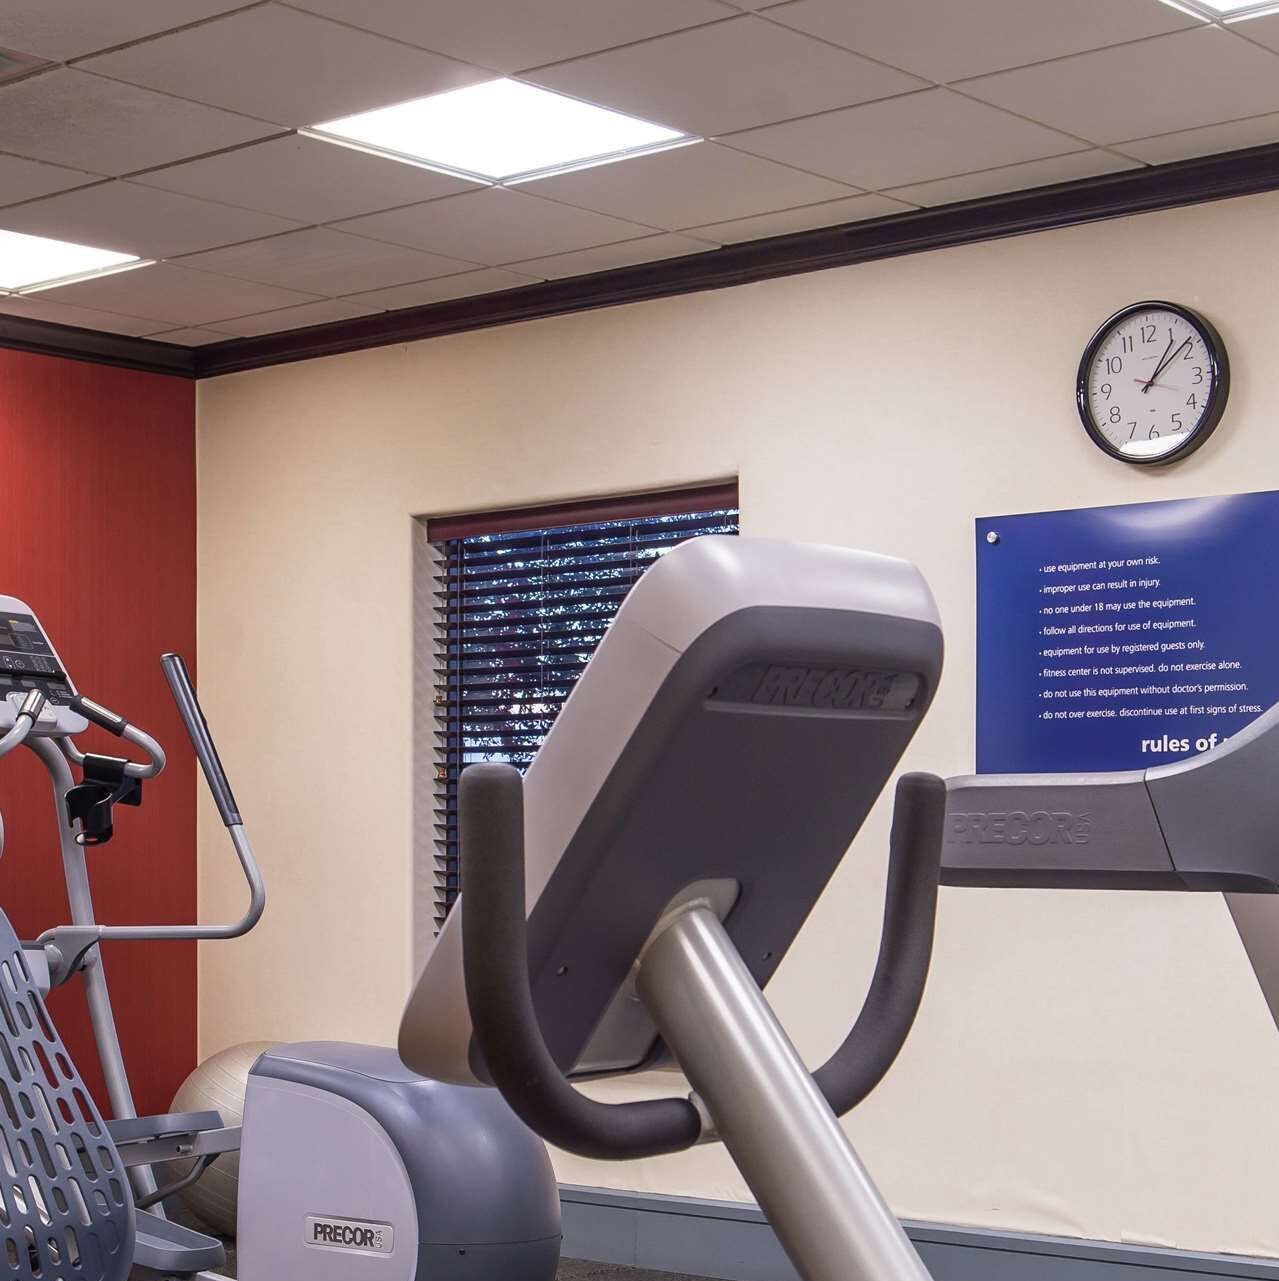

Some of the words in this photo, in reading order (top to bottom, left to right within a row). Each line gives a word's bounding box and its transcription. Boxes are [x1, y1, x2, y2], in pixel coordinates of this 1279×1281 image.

[1140, 324, 1157, 344] 12
[1122, 335, 1134, 354] 11
[1183, 340, 1195, 361] 2
[1105, 356, 1123, 375] 10
[1191, 366, 1203, 385] 3
[1100, 383, 1113, 401] 9
[1186, 392, 1198, 410] 4
[1109, 406, 1121, 424] 8
[1171, 412, 1183, 432] 5
[1127, 421, 1137, 440] 7
[1148, 424, 1160, 441] 6
[1043, 565, 1056, 573] use
[1058, 561, 1097, 573] equipment
[1099, 560, 1106, 569] at
[1108, 560, 1125, 570] your
[1146, 556, 1161, 565] risk.
[1043, 584, 1076, 595] improper
[1078, 583, 1091, 591] use
[1092, 582, 1106, 590] can
[1107, 580, 1128, 589] result
[1130, 579, 1137, 587] in
[1138, 578, 1161, 589] injury.
[1043, 606, 1054, 615] no
[1055, 606, 1070, 614] one
[1071, 603, 1092, 613] under
[1094, 602, 1104, 611] 18
[1105, 603, 1122, 612] may
[1123, 601, 1136, 610] use
[1138, 600, 1151, 609] the
[1152, 597, 1197, 609] equipment.
[1043, 626, 1066, 636] follow
[1067, 625, 1077, 634] all
[1078, 623, 1113, 633] directions
[1115, 622, 1126, 631] for
[1127, 622, 1141, 630] use
[1142, 620, 1151, 630] of
[1152, 619, 1197, 630] equipment.
[1043, 647, 1082, 658] equipment
[1084, 645, 1095, 654] for
[1096, 645, 1109, 653] use
[1111, 644, 1121, 655] by
[1122, 642, 1159, 654] registered
[1160, 641, 1186, 653] guests
[1187, 640, 1206, 650] only.
[1043, 668, 1067, 677] fitness
[1067, 667, 1091, 676] center
[1092, 666, 1099, 675] is
[1100, 665, 1113, 675] not
[1114, 664, 1156, 675] supervised.
[1158, 663, 1169, 672] do
[1170, 663, 1184, 672] not
[1185, 661, 1217, 671] exercise
[1218, 660, 1243, 669] alone.
[1043, 689, 1053, 698] do
[1054, 689, 1067, 698] not
[1069, 689, 1082, 697] use
[1083, 687, 1097, 697] this
[1098, 686, 1139, 698] equipment
[1140, 685, 1170, 694] without
[1171, 684, 1203, 694] doctor's
[1204, 682, 1249, 693] permission.
[1043, 710, 1053, 720] do
[1054, 710, 1067, 719] not
[1069, 710, 1085, 718] over
[1086, 708, 1118, 718] exercise.
[1119, 707, 1163, 717] discontinue
[1164, 706, 1178, 715] use
[1179, 706, 1188, 715] at
[1189, 705, 1205, 715] first
[1206, 704, 1227, 716] signs
[1228, 703, 1238, 713] of
[1239, 703, 1264, 713] stress.
[1141, 734, 1190, 753] rules
[1195, 733, 1218, 752] of
[313, 1222, 375, 1247] PRECOR
